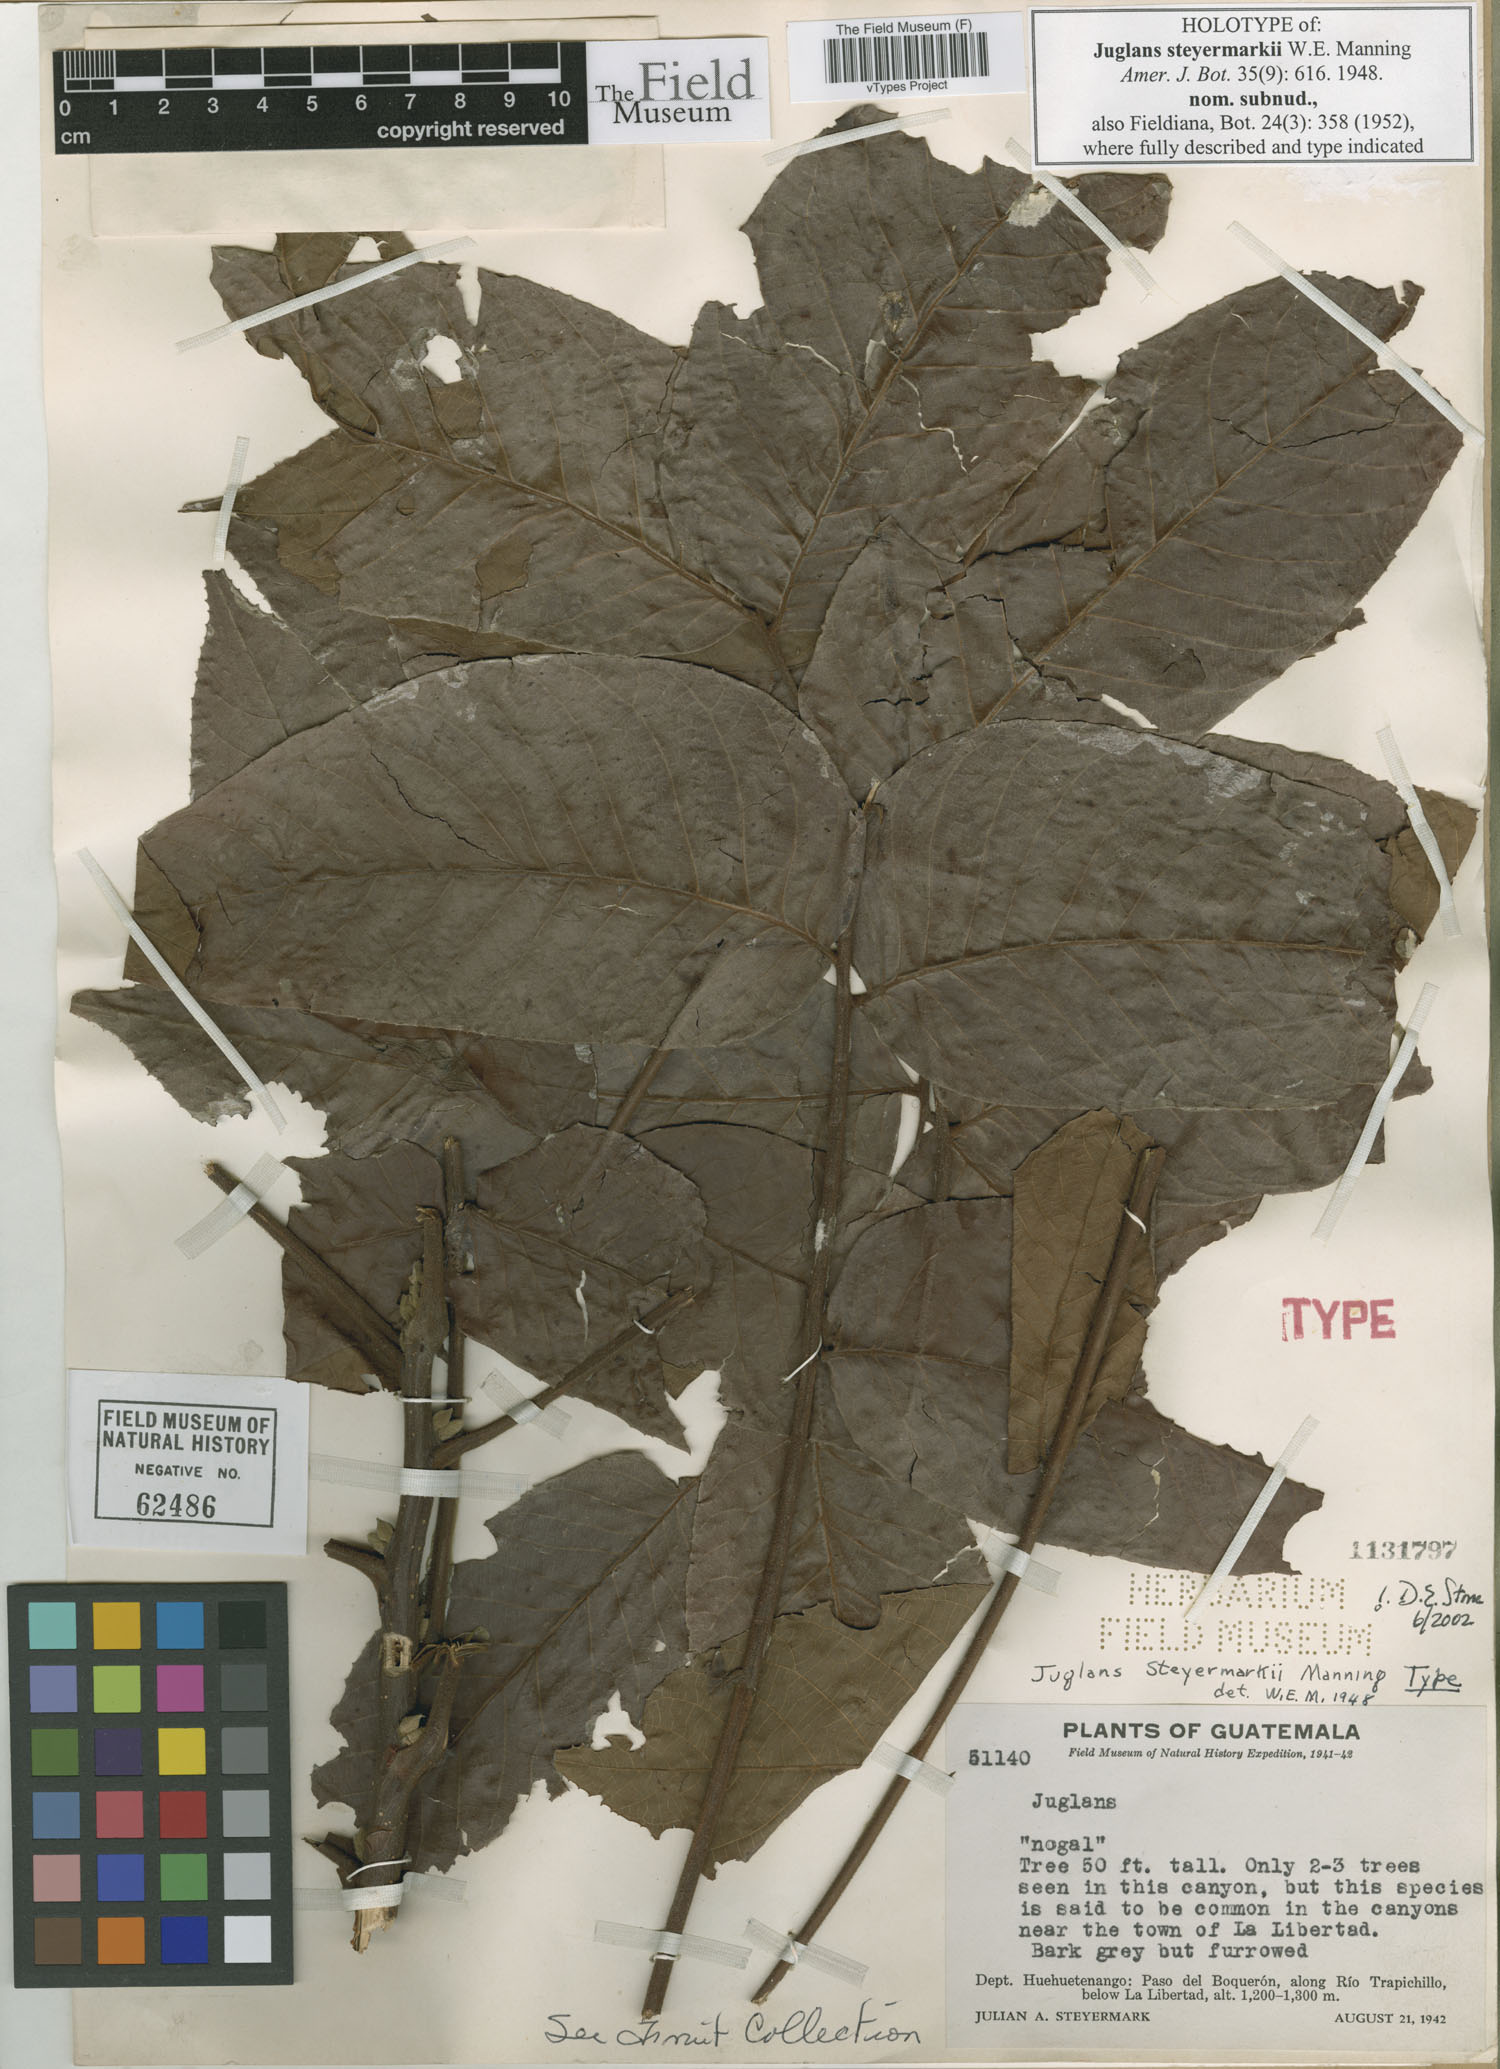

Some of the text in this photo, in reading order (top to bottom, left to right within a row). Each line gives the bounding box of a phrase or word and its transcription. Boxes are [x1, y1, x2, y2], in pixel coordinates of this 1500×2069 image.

[836, 19, 971, 35] The Field Museum (F)
[1182, 16, 1320, 33] HOLOTYPE of:
[1094, 40, 1411, 62] Juglans steyermarkii W.E. Manning
[595, 57, 756, 102] The Field
[1120, 65, 1382, 85] Amer. J. Bot. 35(9): 616. 1948.
[867, 80, 947, 94] vTypes Project
[59, 91, 570, 116] 0 1 2 3 4 5 6 7 8 9 10
[1190, 91, 1317, 108] nom. subnud.,
[613, 101, 732, 124] Museum
[377, 119, 564, 141] copyright reserved
[1092, 114, 1414, 133] also Fieldiana, Bot. 24(3): 358 (1952),
[61, 132, 90, 144] cm
[1083, 138, 1424, 159] where fully described and type indicated
[1282, 1297, 1396, 1342] TYPE
[104, 1410, 271, 1434] FIELD MUSEUM OF
[103, 1431, 269, 1455] NATURAL HISTORY
[135, 1463, 240, 1479] NEGATIVE NO.
[137, 1493, 216, 1518] 62486
[1351, 1541, 1457, 1560] 1131797
[1413, 1607, 1474, 1635] 6/2002
[1099, 1615, 1374, 1658] FIELD MUSEUM
[1031, 1662, 1121, 1691] Juglans
[1301, 1664, 1386, 1693] Manning
[1404, 1665, 1462, 1697] Type
[1334, 1692, 1375, 1706] 1948
[1064, 1723, 1360, 1740] PLANTS OF GUATEMALA
[1069, 1748, 1095, 1757] Field
[1099, 1748, 1142, 1757] Museum
[1146, 1748, 1157, 1759] of
[1160, 1748, 1200, 1757] Natural
[1204, 1749, 1243, 1759] History
[1247, 1749, 1306, 1760] Expedition,
[1032, 1793, 1116, 1813] Juglans
[1020, 1857, 1420, 1877] Tree 50 ft. tall. Only 2-3 trees
[1019, 1879, 1483, 1899] seen in this canyon, but this species
[1022, 1900, 1458, 1920] is said to be common in the canyons
[1019, 1921, 1378, 1937] near the town of La Libertad.
[1032, 1943, 1308, 1962] Bark grey but furrowed
[976, 1974, 1446, 1991] Dept. Huehuetenango: Paso del Boquerón, along Río Trapichillo,
[1082, 1988, 1119, 2000] below
[1125, 1989, 1142, 2000] La
[1148, 1989, 1208, 2002] Libertad,
[1214, 1989, 1235, 2000] alt.
[1323, 1993, 1339, 2001] m.
[545, 2014, 606, 2044] See
[745, 1998, 920, 2044] Collection
[975, 2011, 1150, 2024] JULIAN A. STEYERMARK
[1335, 2013, 1446, 2025] AUGUST 21, 1942
